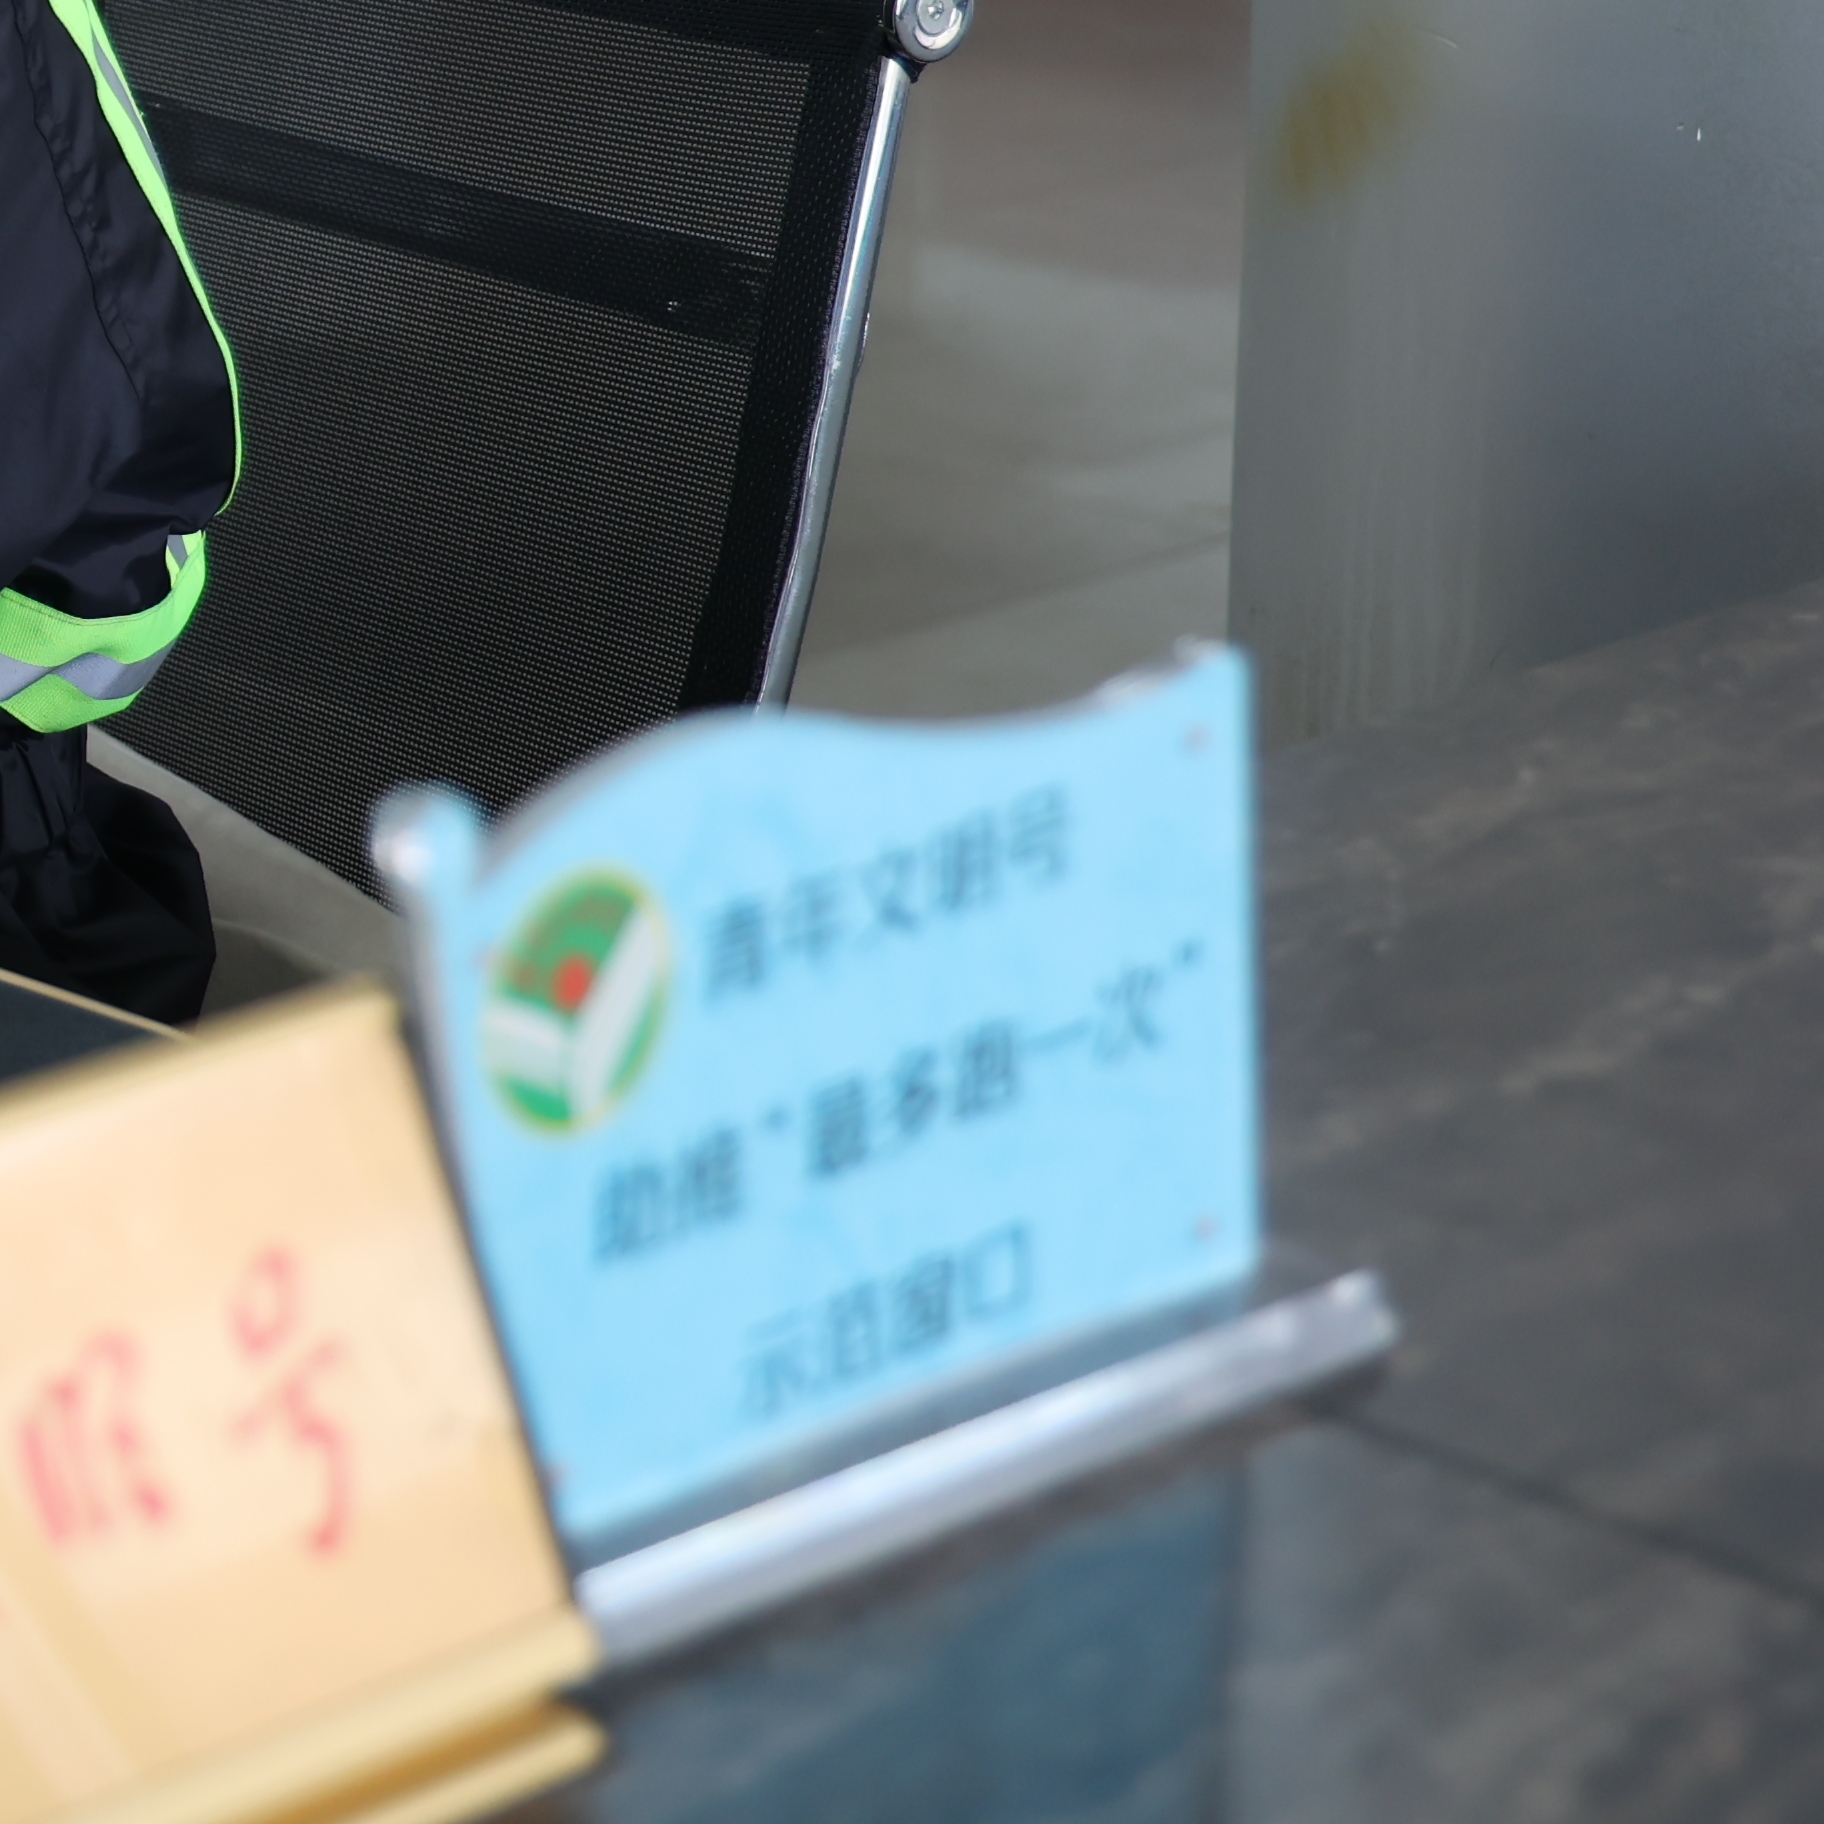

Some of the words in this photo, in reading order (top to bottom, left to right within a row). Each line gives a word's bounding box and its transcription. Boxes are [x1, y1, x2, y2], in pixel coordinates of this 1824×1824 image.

[702, 780, 1074, 1008] 青年文明号
